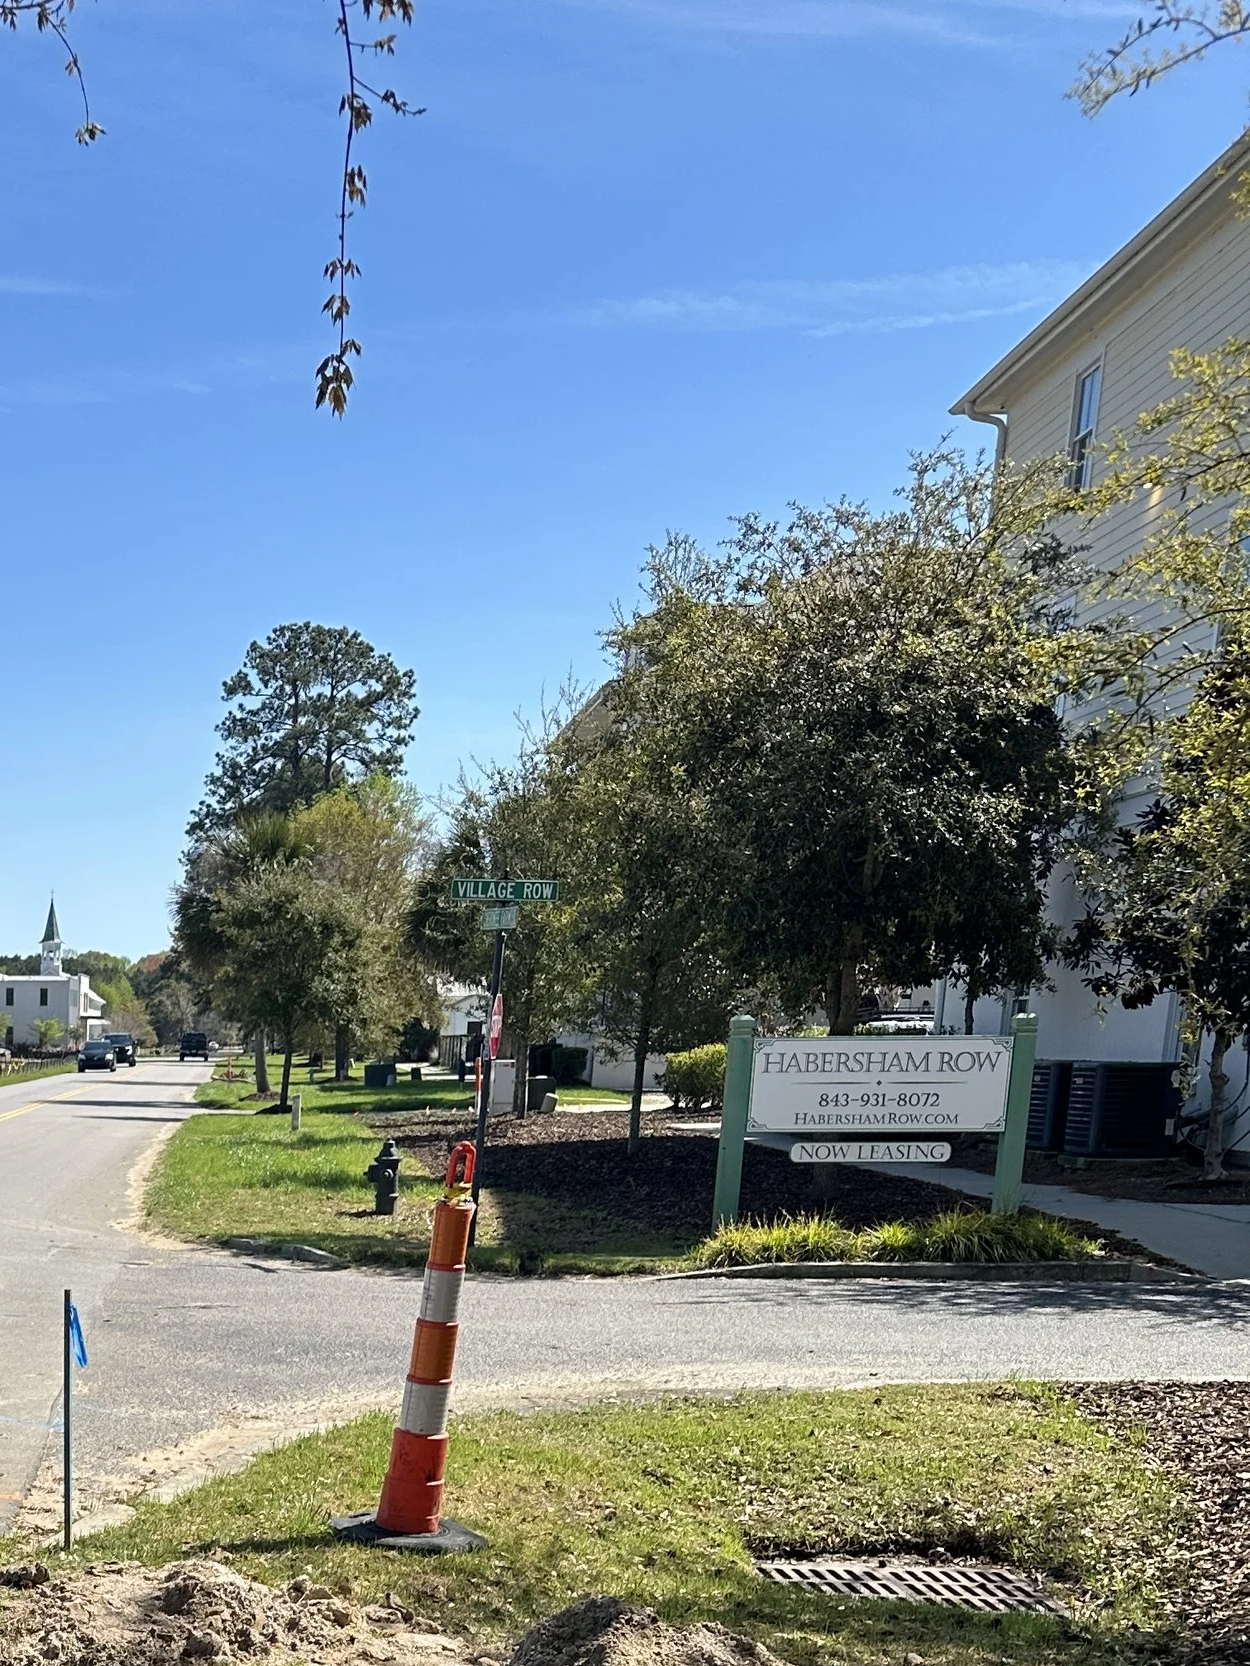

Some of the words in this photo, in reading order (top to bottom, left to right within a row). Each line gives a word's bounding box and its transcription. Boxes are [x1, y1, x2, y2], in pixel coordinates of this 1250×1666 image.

[457, 881, 516, 899] VILLAGE
[523, 883, 554, 899] ROW
[761, 1051, 933, 1074] HABERSHAM
[937, 1051, 1003, 1073] ROW
[818, 1092, 940, 1108] 843-931-8072
[799, 1144, 851, 1161] NOW
[857, 1144, 946, 1161] LEASING
